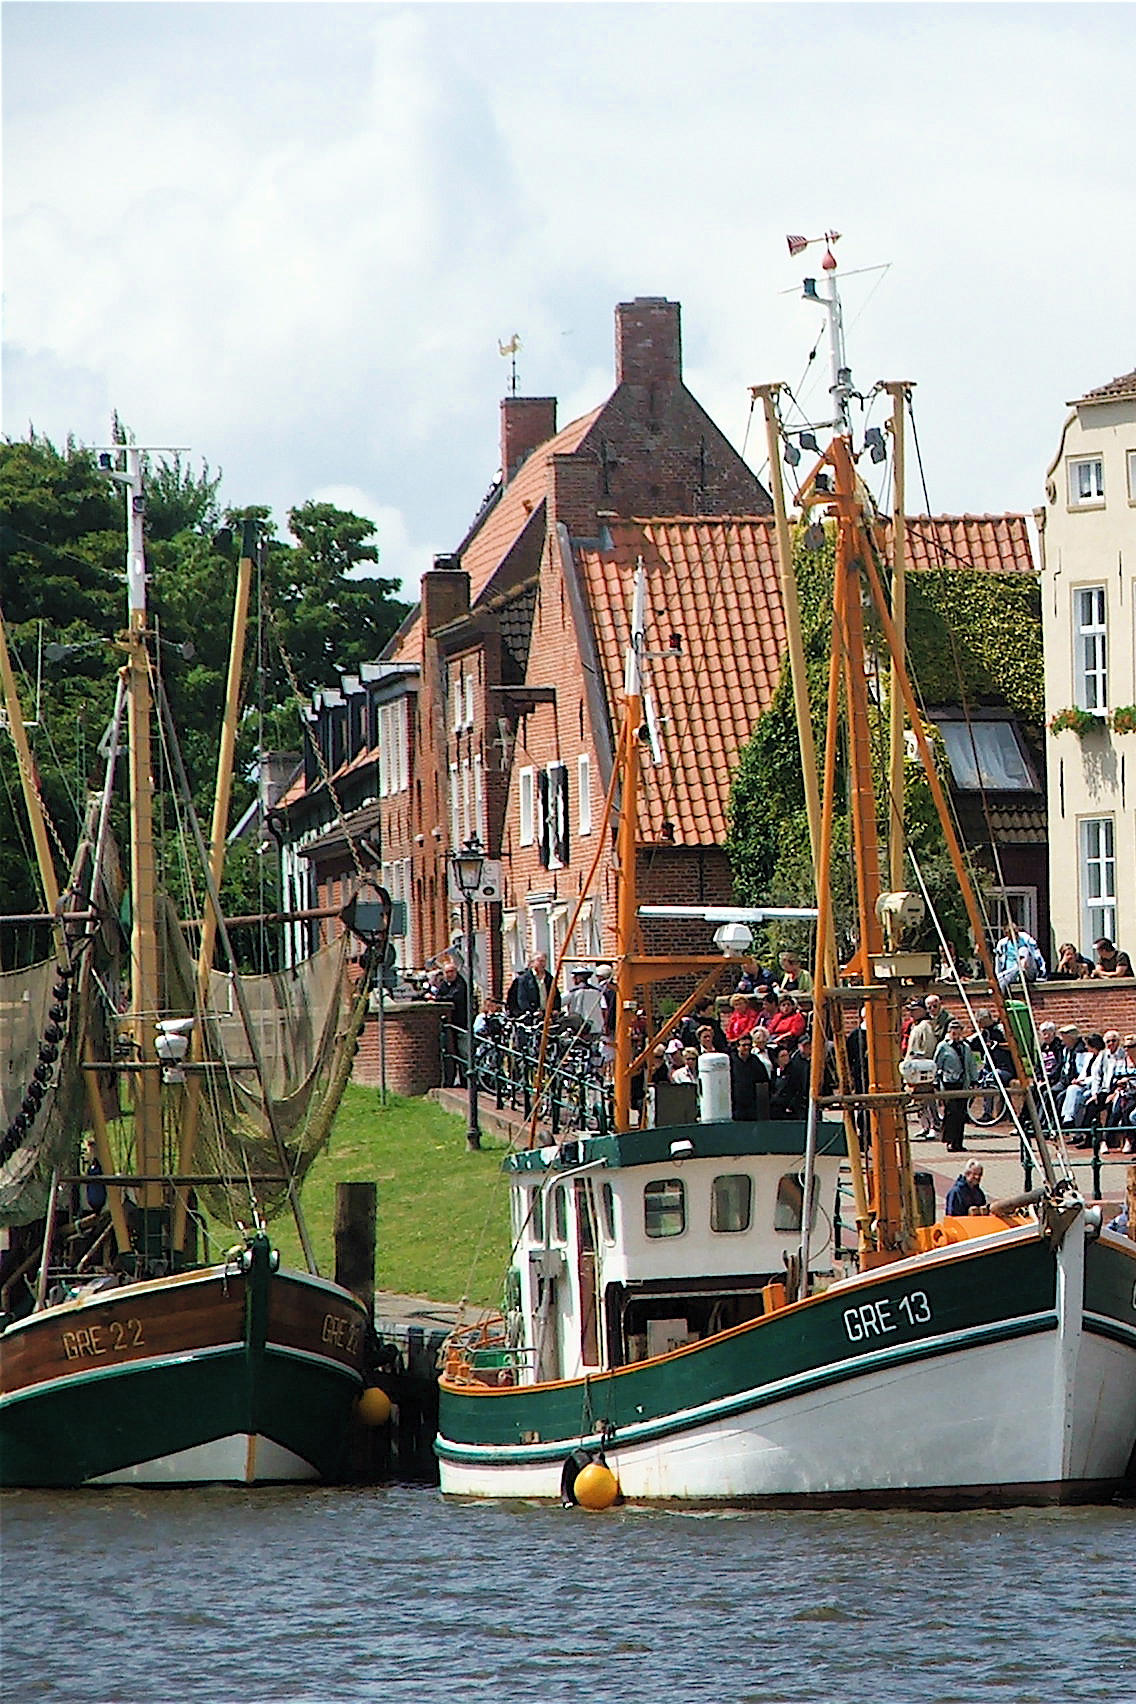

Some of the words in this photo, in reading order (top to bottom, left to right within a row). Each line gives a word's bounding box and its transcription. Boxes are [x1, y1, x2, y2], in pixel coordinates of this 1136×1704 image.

[322, 1313, 348, 1347] GRE
[843, 1299, 897, 1341] GRE
[898, 1291, 931, 1325] 13
[63, 1325, 107, 1360] GRE
[109, 1318, 145, 1350] 22
